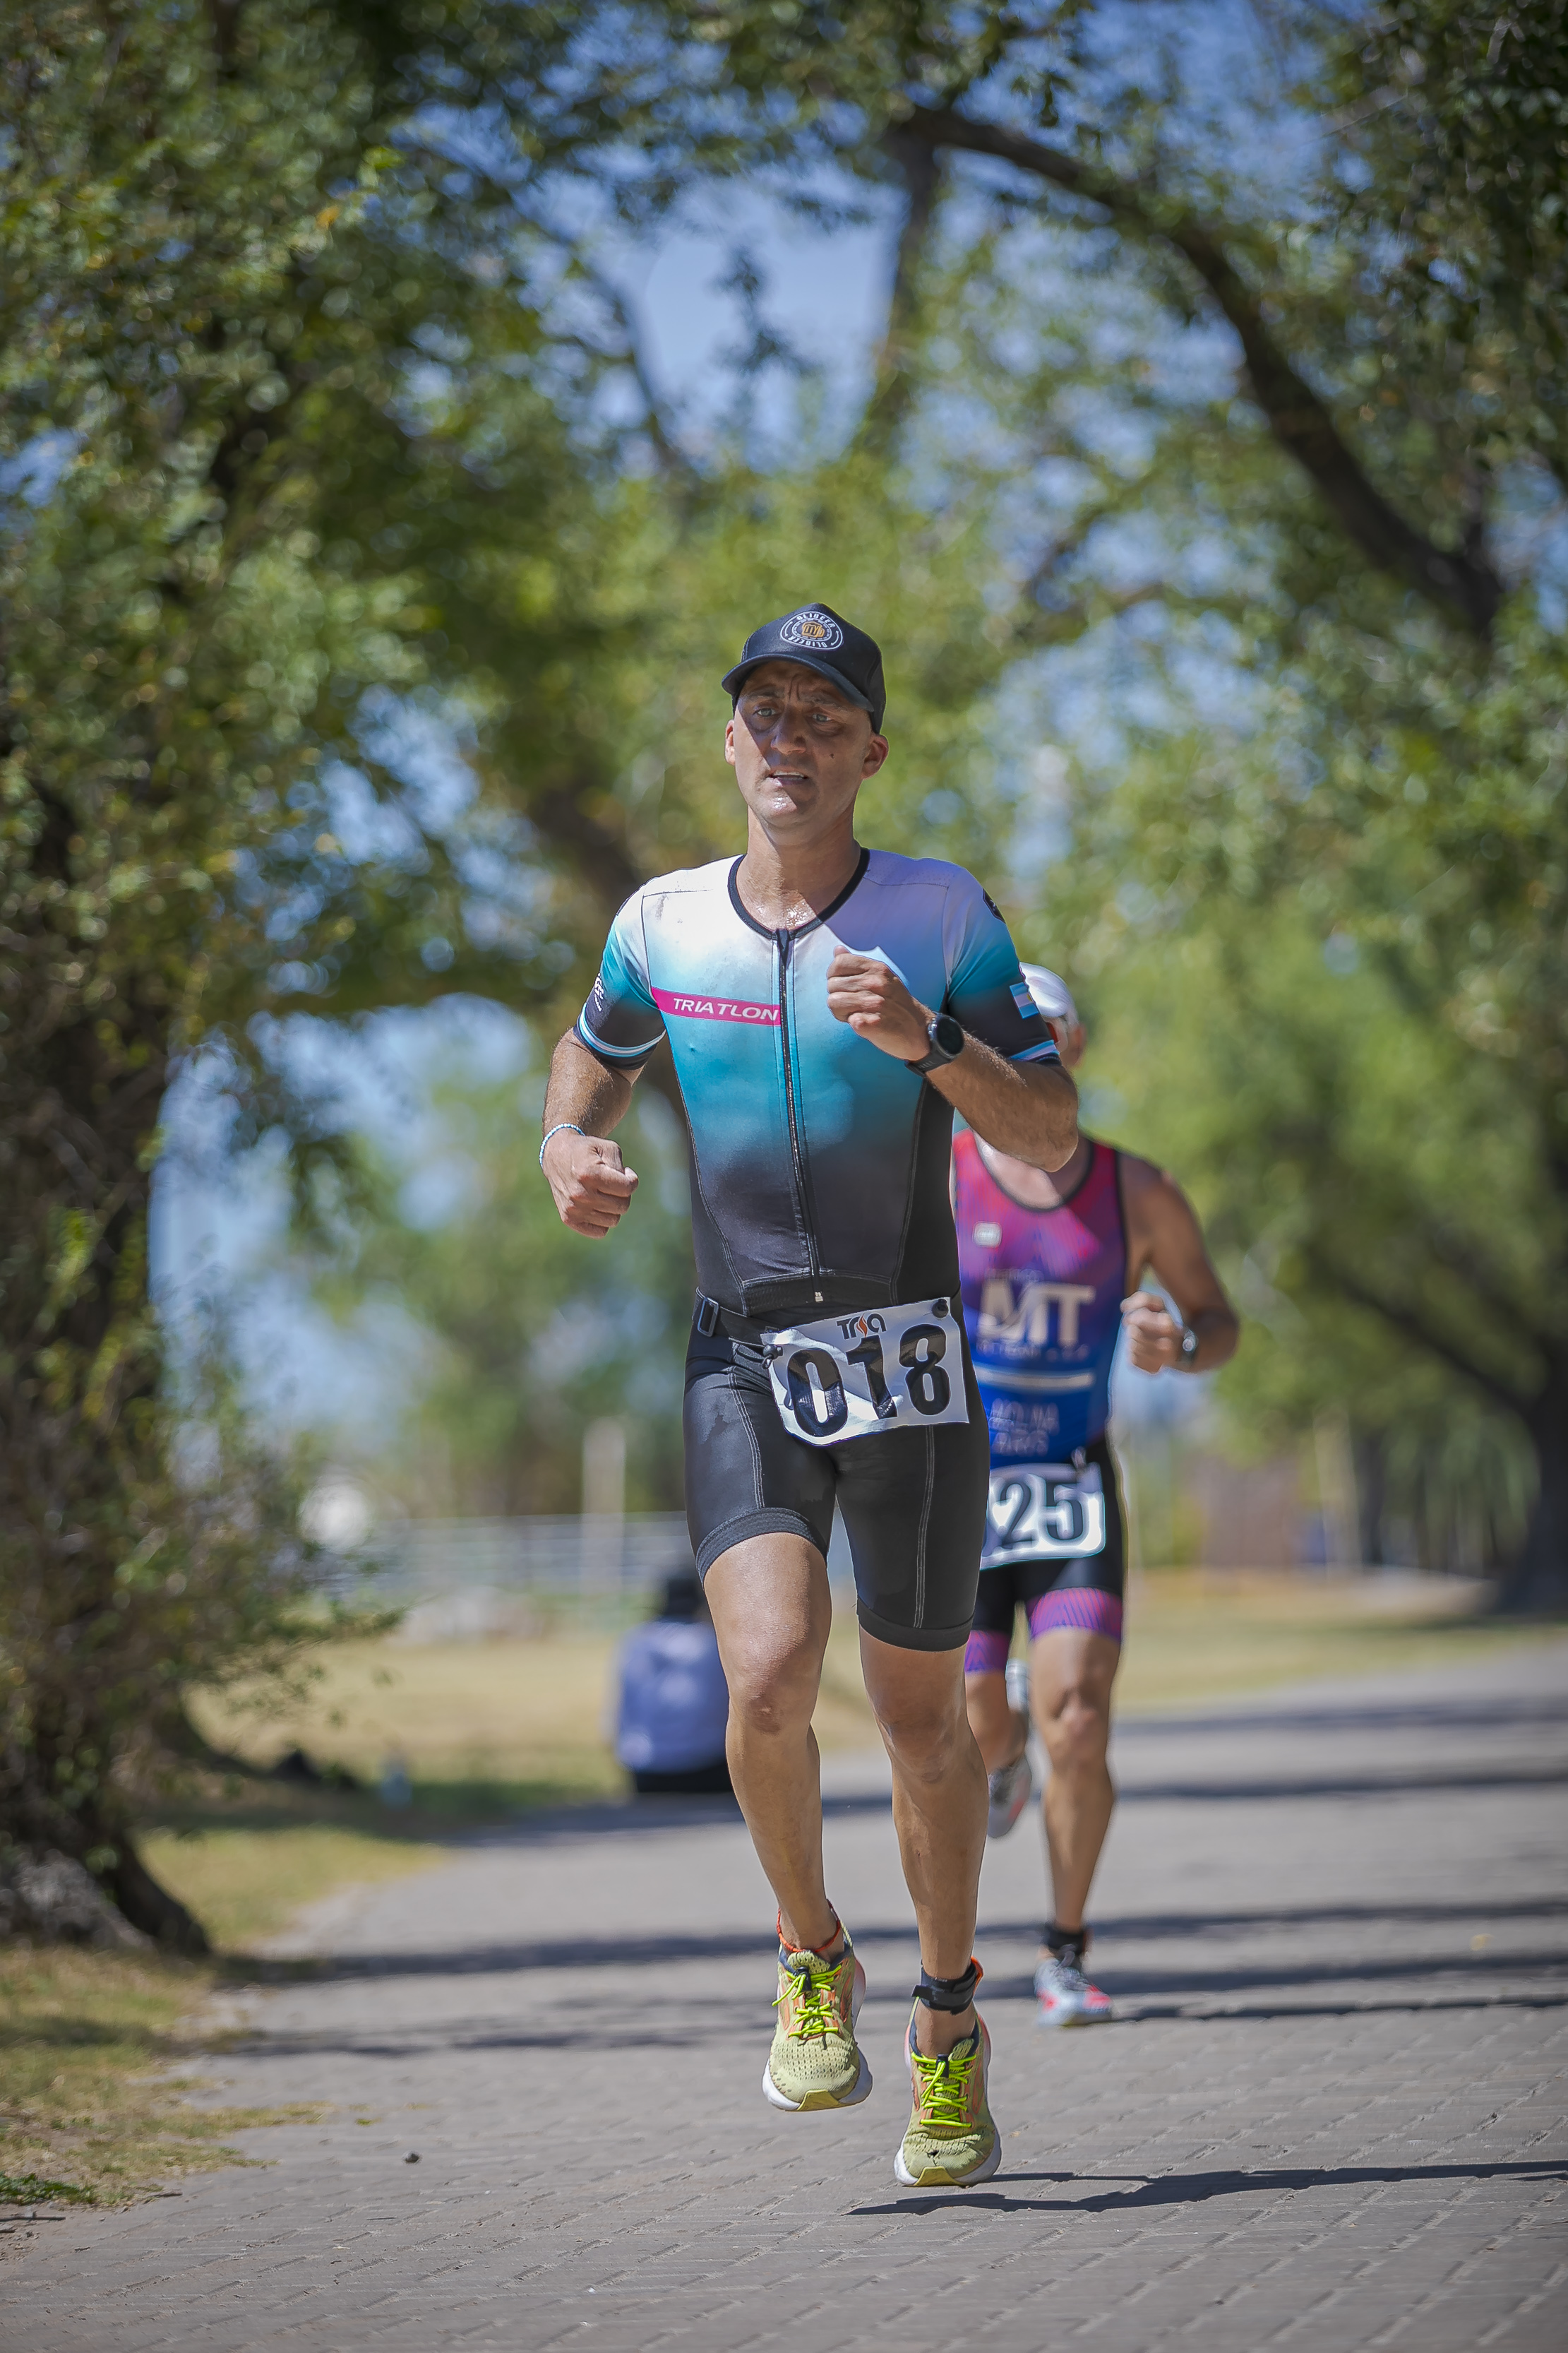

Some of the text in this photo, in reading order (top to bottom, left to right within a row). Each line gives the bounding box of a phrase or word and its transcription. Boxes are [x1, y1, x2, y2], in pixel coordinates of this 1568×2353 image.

[673, 997, 779, 1021] TRIATLON
[978, 1278, 1096, 1347] MT
[787, 1324, 951, 1437] 018
